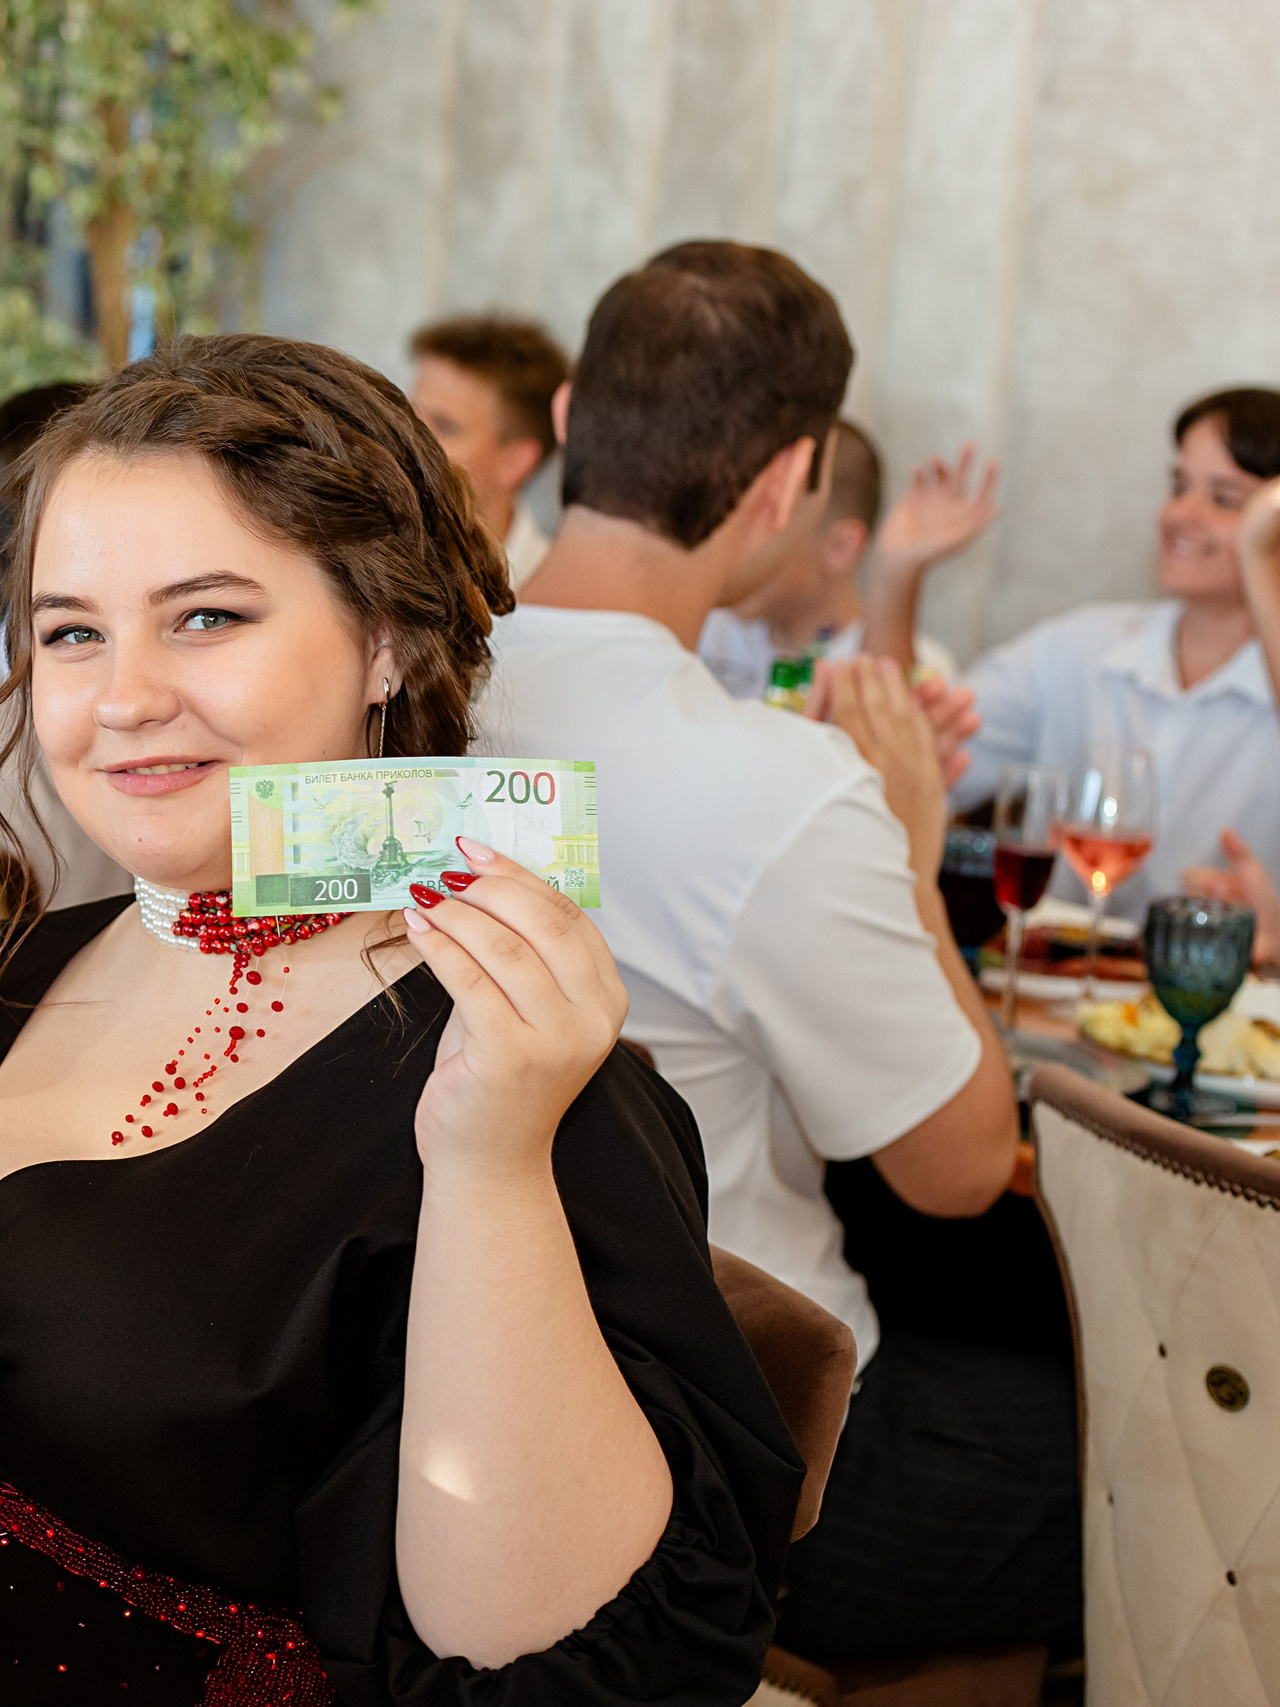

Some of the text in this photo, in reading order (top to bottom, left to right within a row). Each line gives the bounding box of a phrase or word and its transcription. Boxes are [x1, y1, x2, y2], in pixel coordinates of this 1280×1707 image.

[305, 769, 433, 784] БИЛЕТ БАНКА ПРИКОЛОВ
[484, 770, 555, 805] 200
[314, 878, 358, 901] 200
